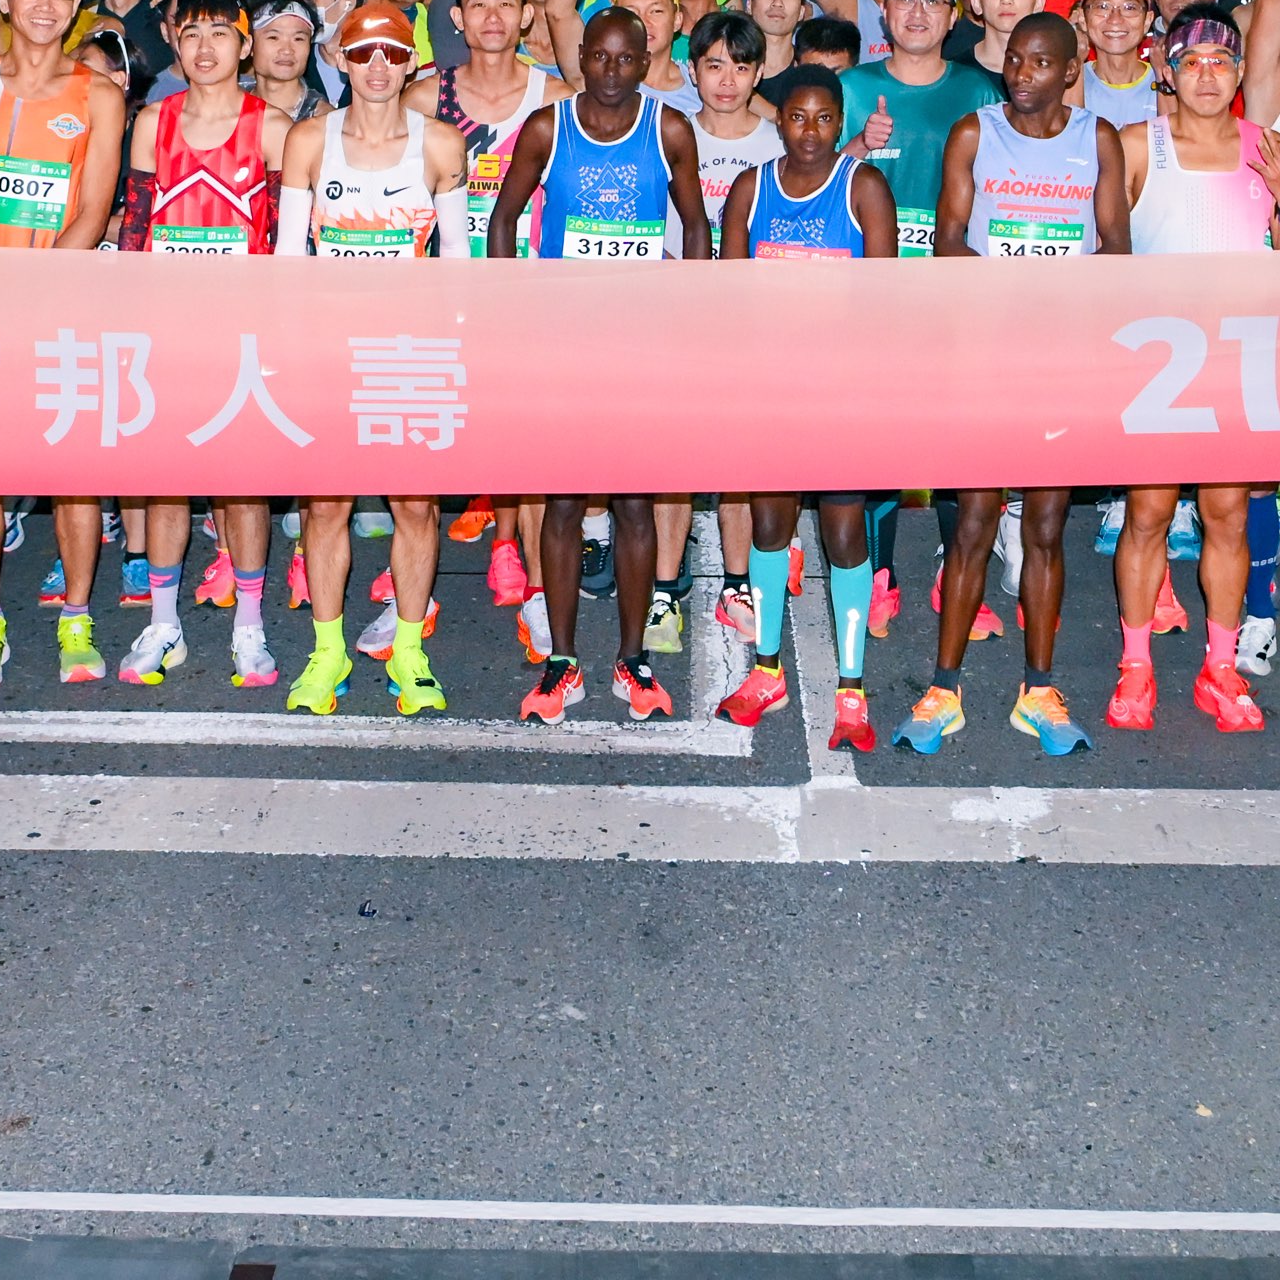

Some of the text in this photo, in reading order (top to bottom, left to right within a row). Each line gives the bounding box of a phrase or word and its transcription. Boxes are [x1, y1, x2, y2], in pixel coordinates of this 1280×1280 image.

[1153, 123, 1167, 170] FLIPBELT
[712, 157, 726, 166] OF
[730, 157, 755, 169] AME
[346, 186, 361, 194] NN
[468, 181, 502, 191] AIWA
[983, 178, 1093, 200] KAOHSIUNG
[598, 193, 620, 203] 400
[577, 238, 649, 257] 31376
[999, 242, 1071, 257] 34597
